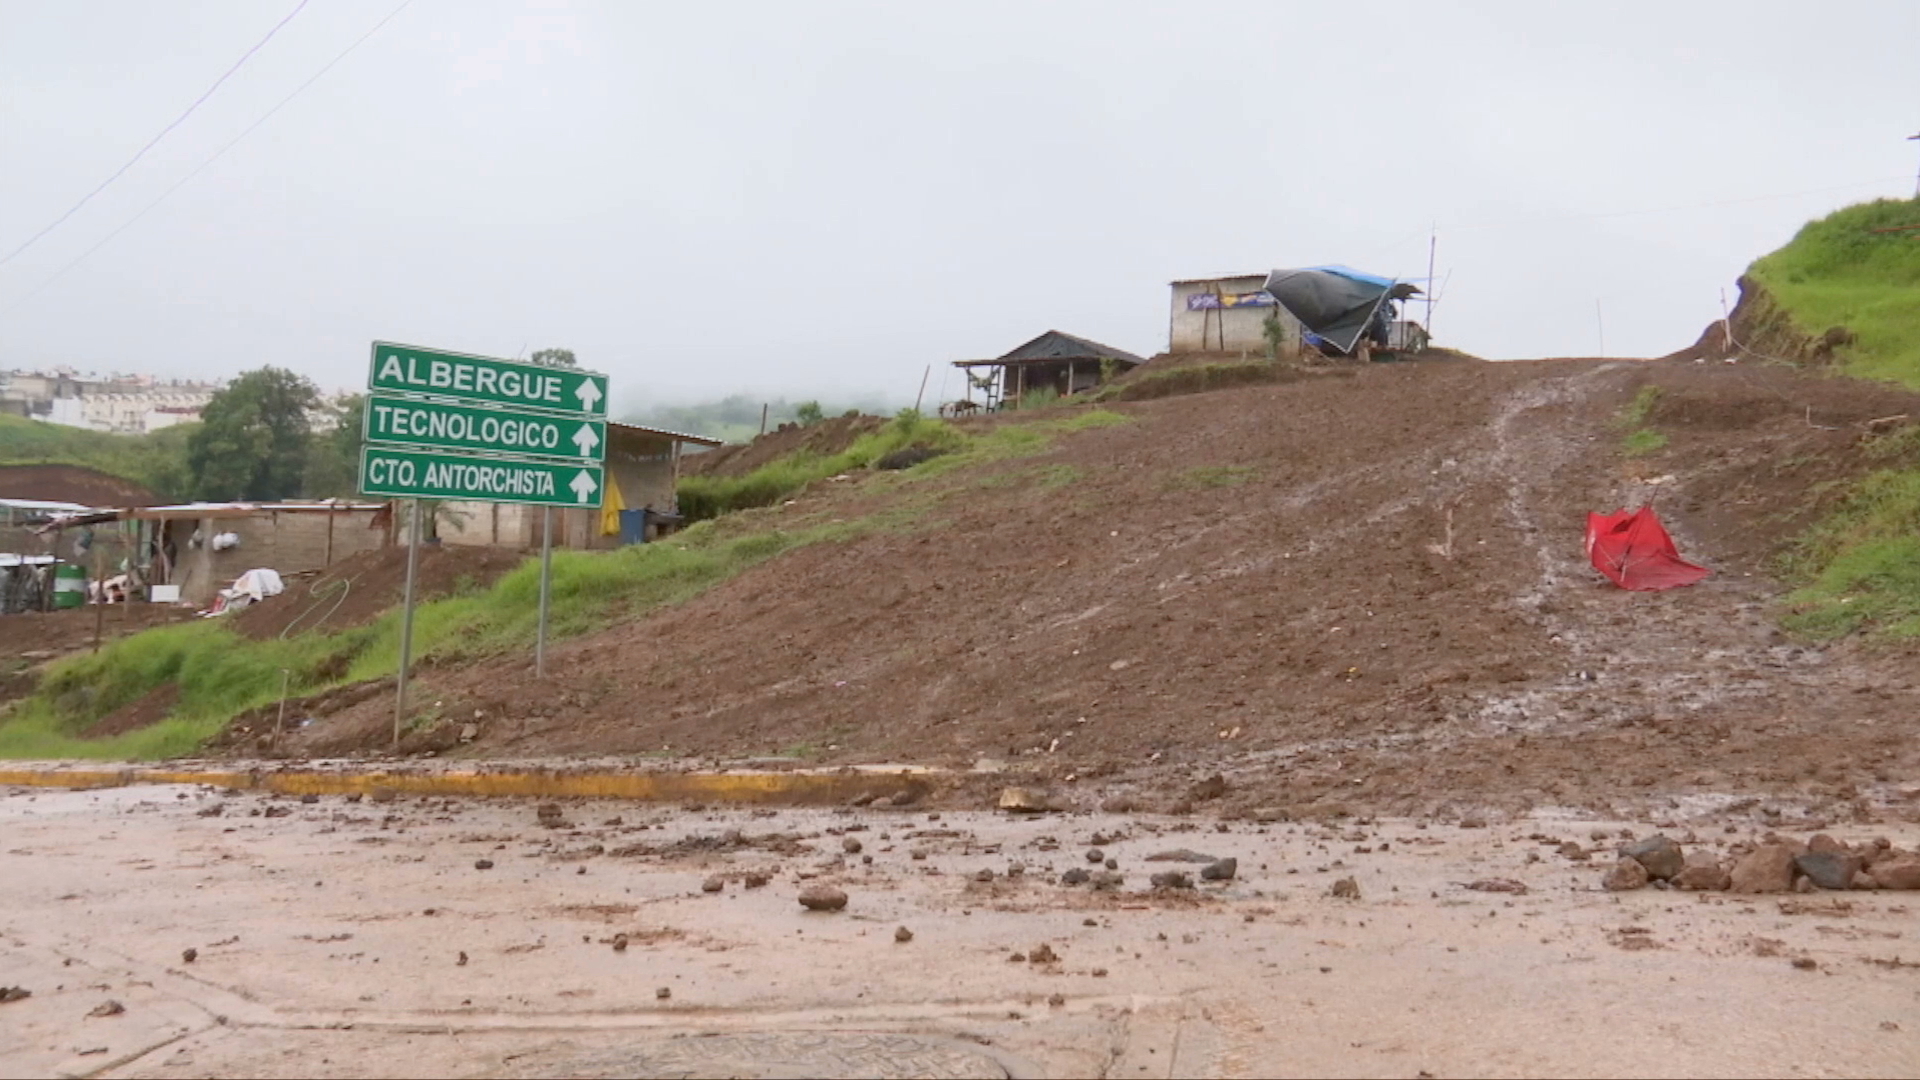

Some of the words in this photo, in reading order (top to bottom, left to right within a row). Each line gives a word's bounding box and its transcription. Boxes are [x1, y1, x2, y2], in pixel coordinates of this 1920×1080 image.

[378, 355, 562, 402] ALBERGUE
[374, 405, 559, 448] TECNOLOGICO
[369, 457, 417, 487] CTO.
[423, 461, 555, 496] ANTORCHISTA
